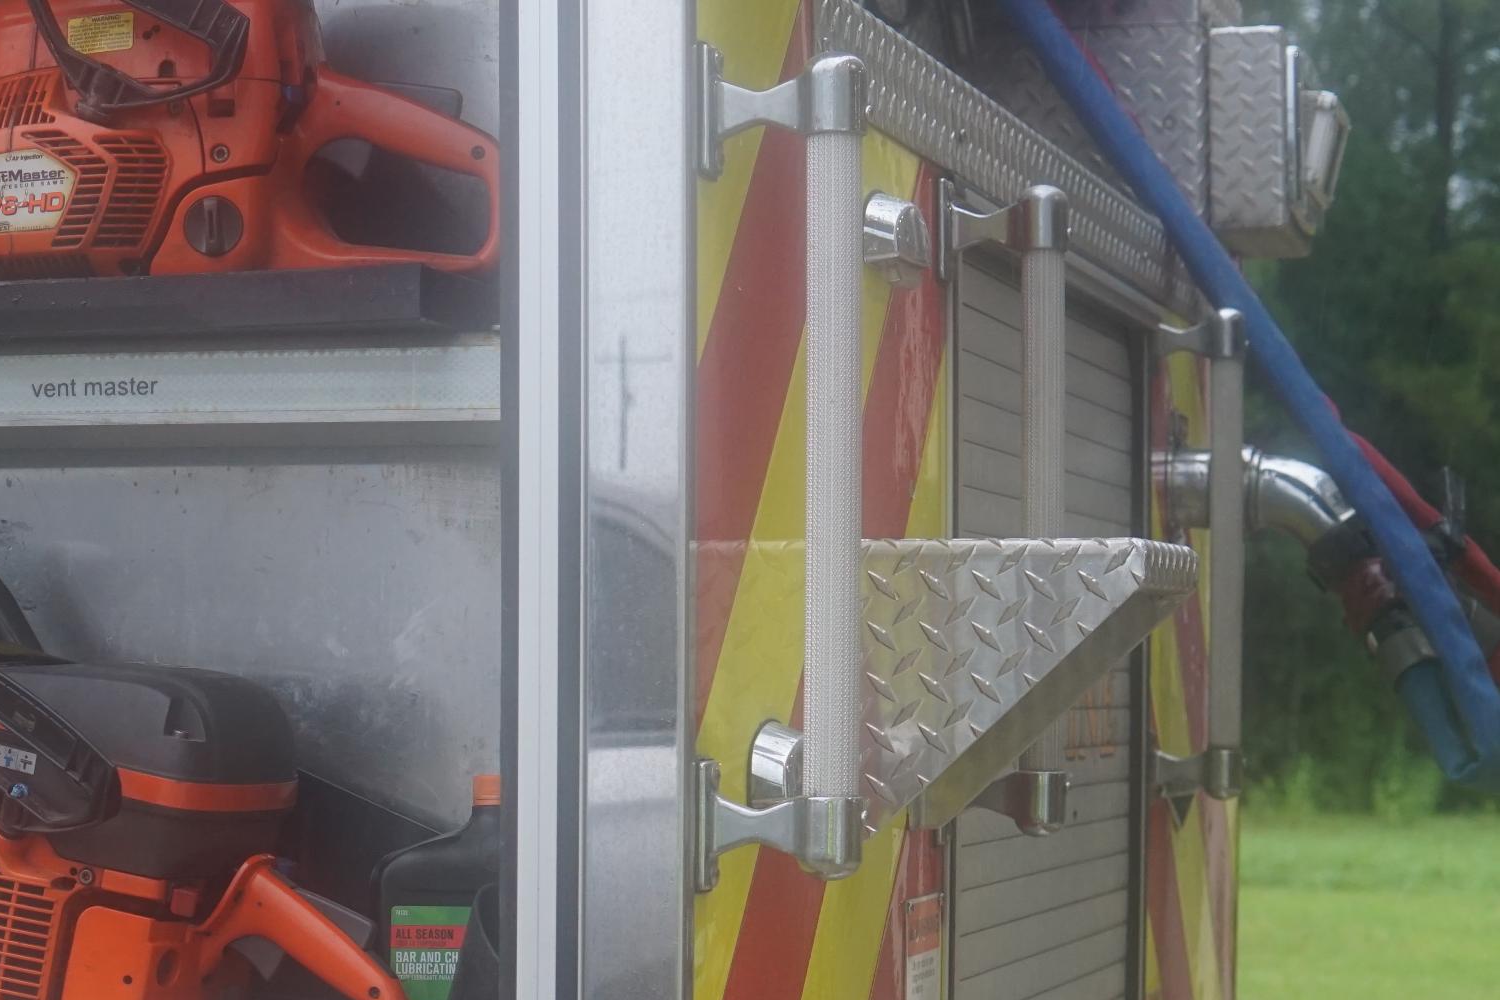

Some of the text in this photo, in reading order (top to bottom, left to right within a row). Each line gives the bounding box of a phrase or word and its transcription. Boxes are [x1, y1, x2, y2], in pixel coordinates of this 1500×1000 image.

[31, 377, 158, 398] vent master
[395, 928, 454, 940] ALL SEASON
[395, 951, 417, 963] BAR
[419, 951, 441, 963] AND
[395, 963, 456, 975] LUBRICATIN
